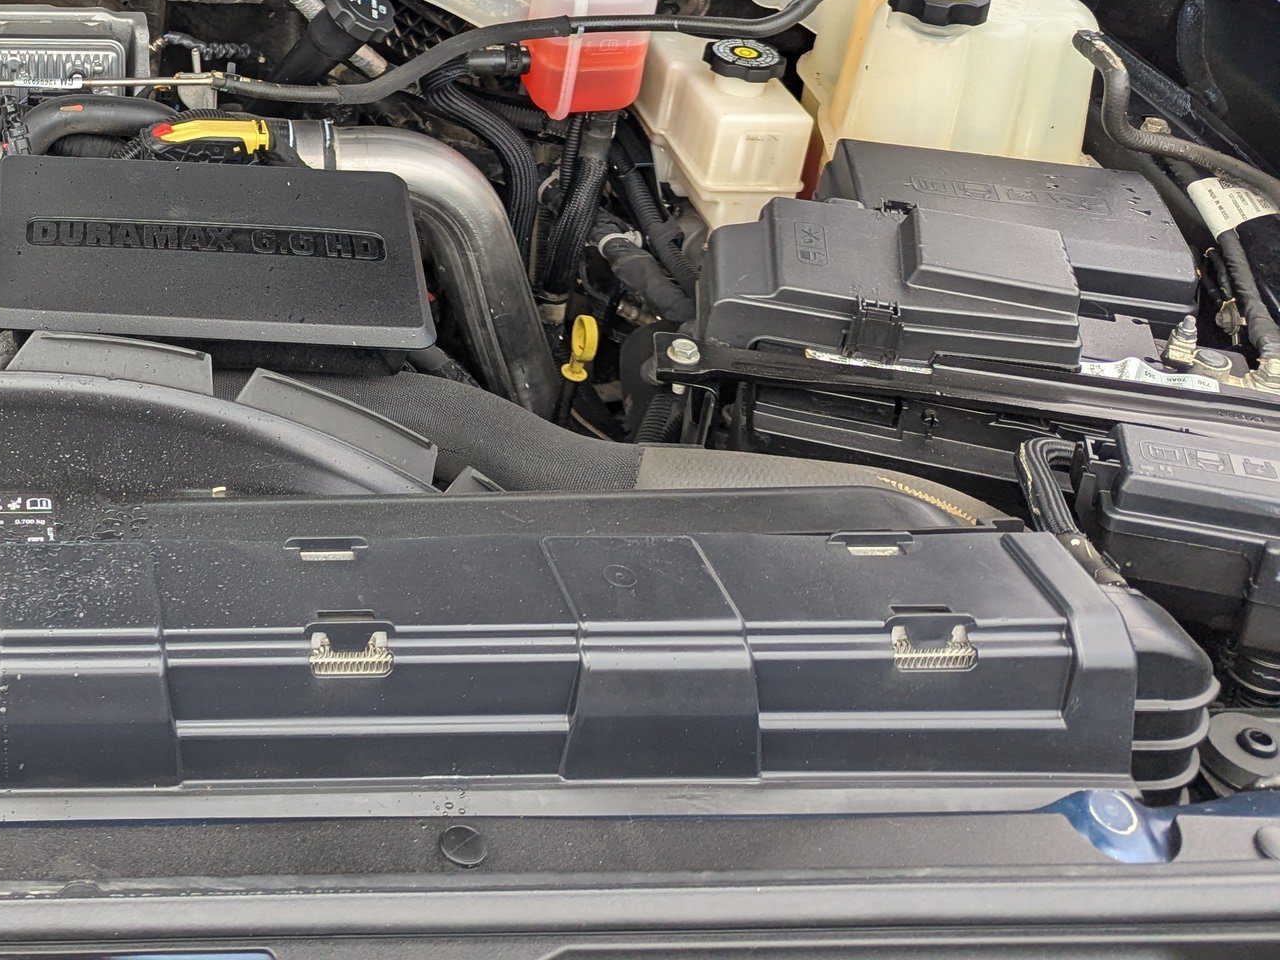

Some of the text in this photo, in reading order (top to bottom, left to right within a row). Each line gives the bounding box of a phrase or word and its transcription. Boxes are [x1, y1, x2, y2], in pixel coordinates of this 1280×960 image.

[31, 220, 380, 260] DURAMAX 6.6 HD
